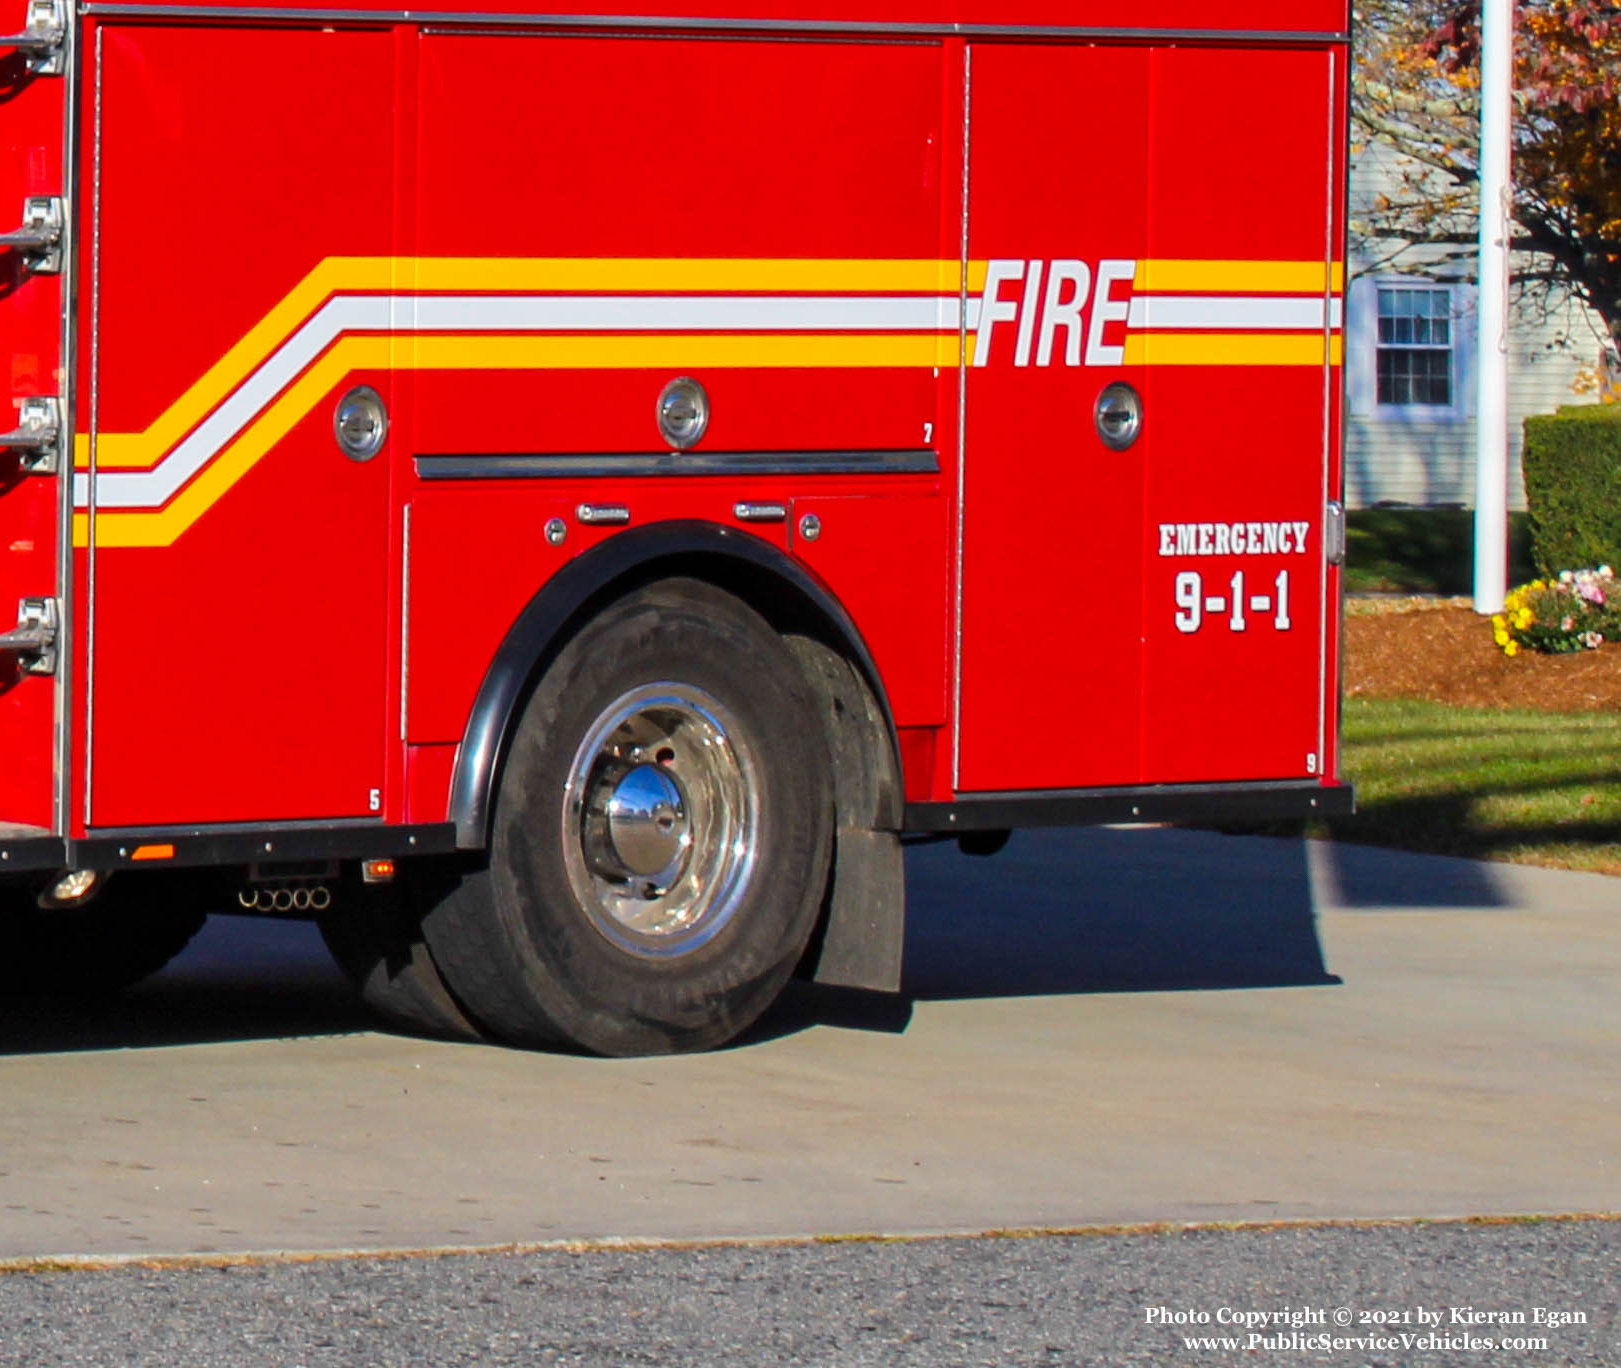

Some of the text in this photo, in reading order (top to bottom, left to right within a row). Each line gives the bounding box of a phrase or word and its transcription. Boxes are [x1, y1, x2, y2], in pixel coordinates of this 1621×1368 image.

[972, 259, 1136, 367] FIRE
[923, 422, 933, 443] 7
[1159, 521, 1310, 556] EMERGENCY
[1175, 570, 1291, 633] 9-1-1
[1306, 752, 1317, 774] 9
[369, 788, 380, 811] 5
